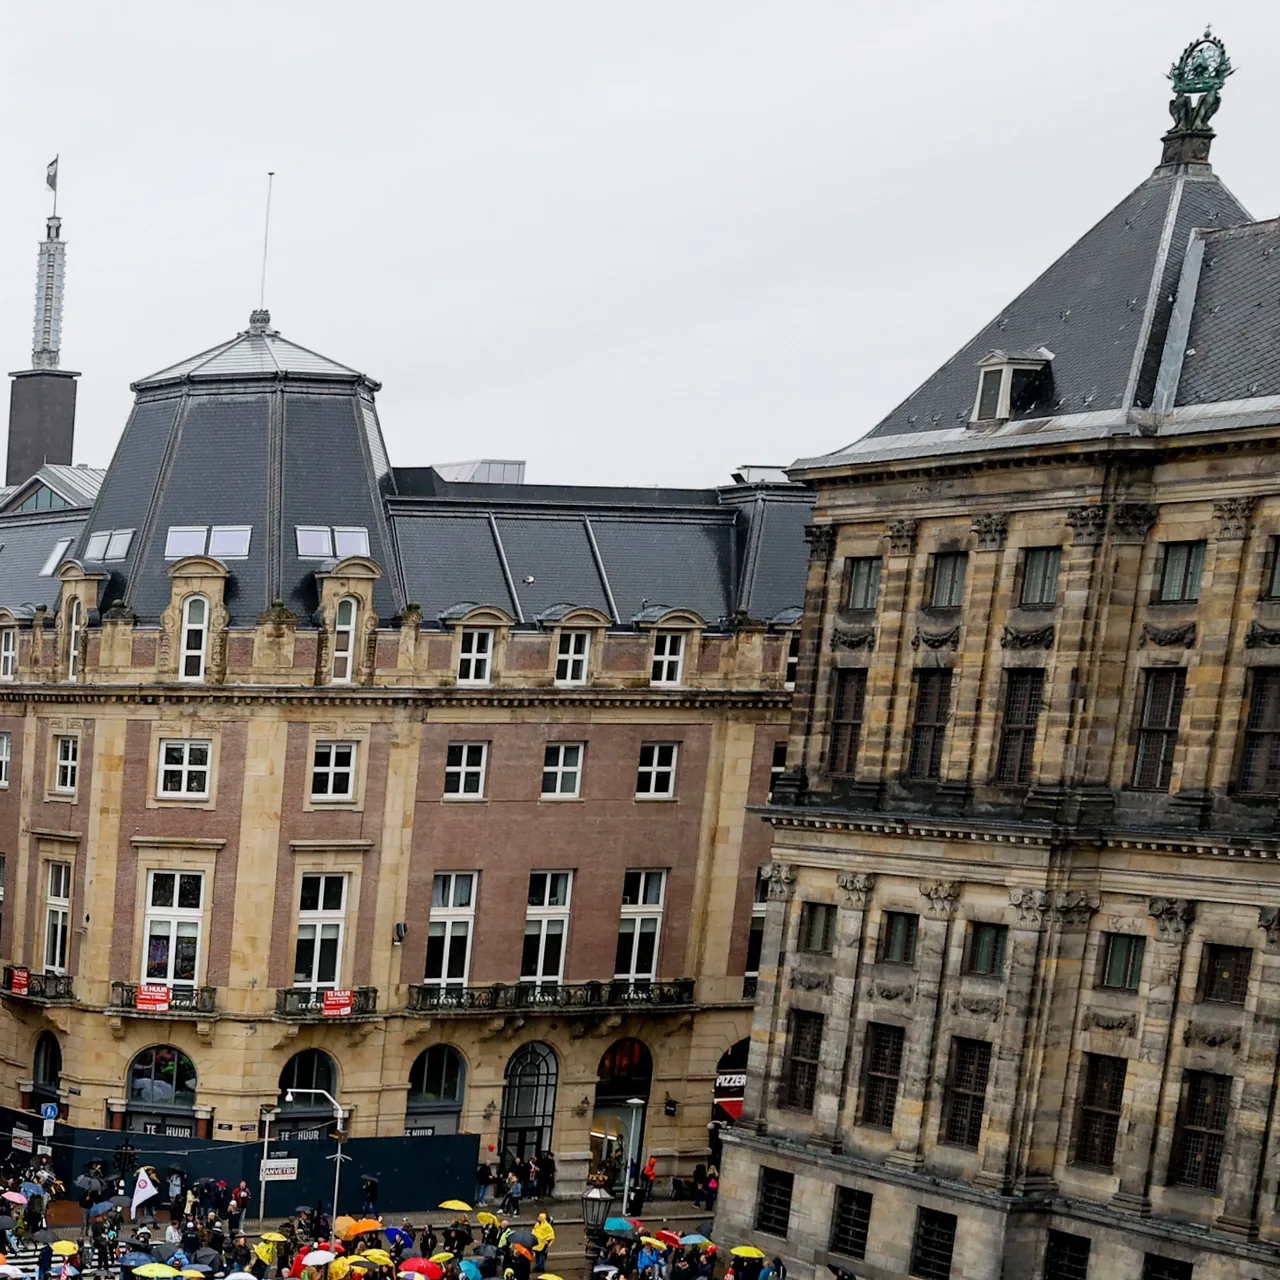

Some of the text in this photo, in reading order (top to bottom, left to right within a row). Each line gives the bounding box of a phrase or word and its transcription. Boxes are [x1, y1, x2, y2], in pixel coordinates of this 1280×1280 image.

[146, 1125, 191, 1138] TE HUUR
[281, 1130, 319, 1141] TE HUUR
